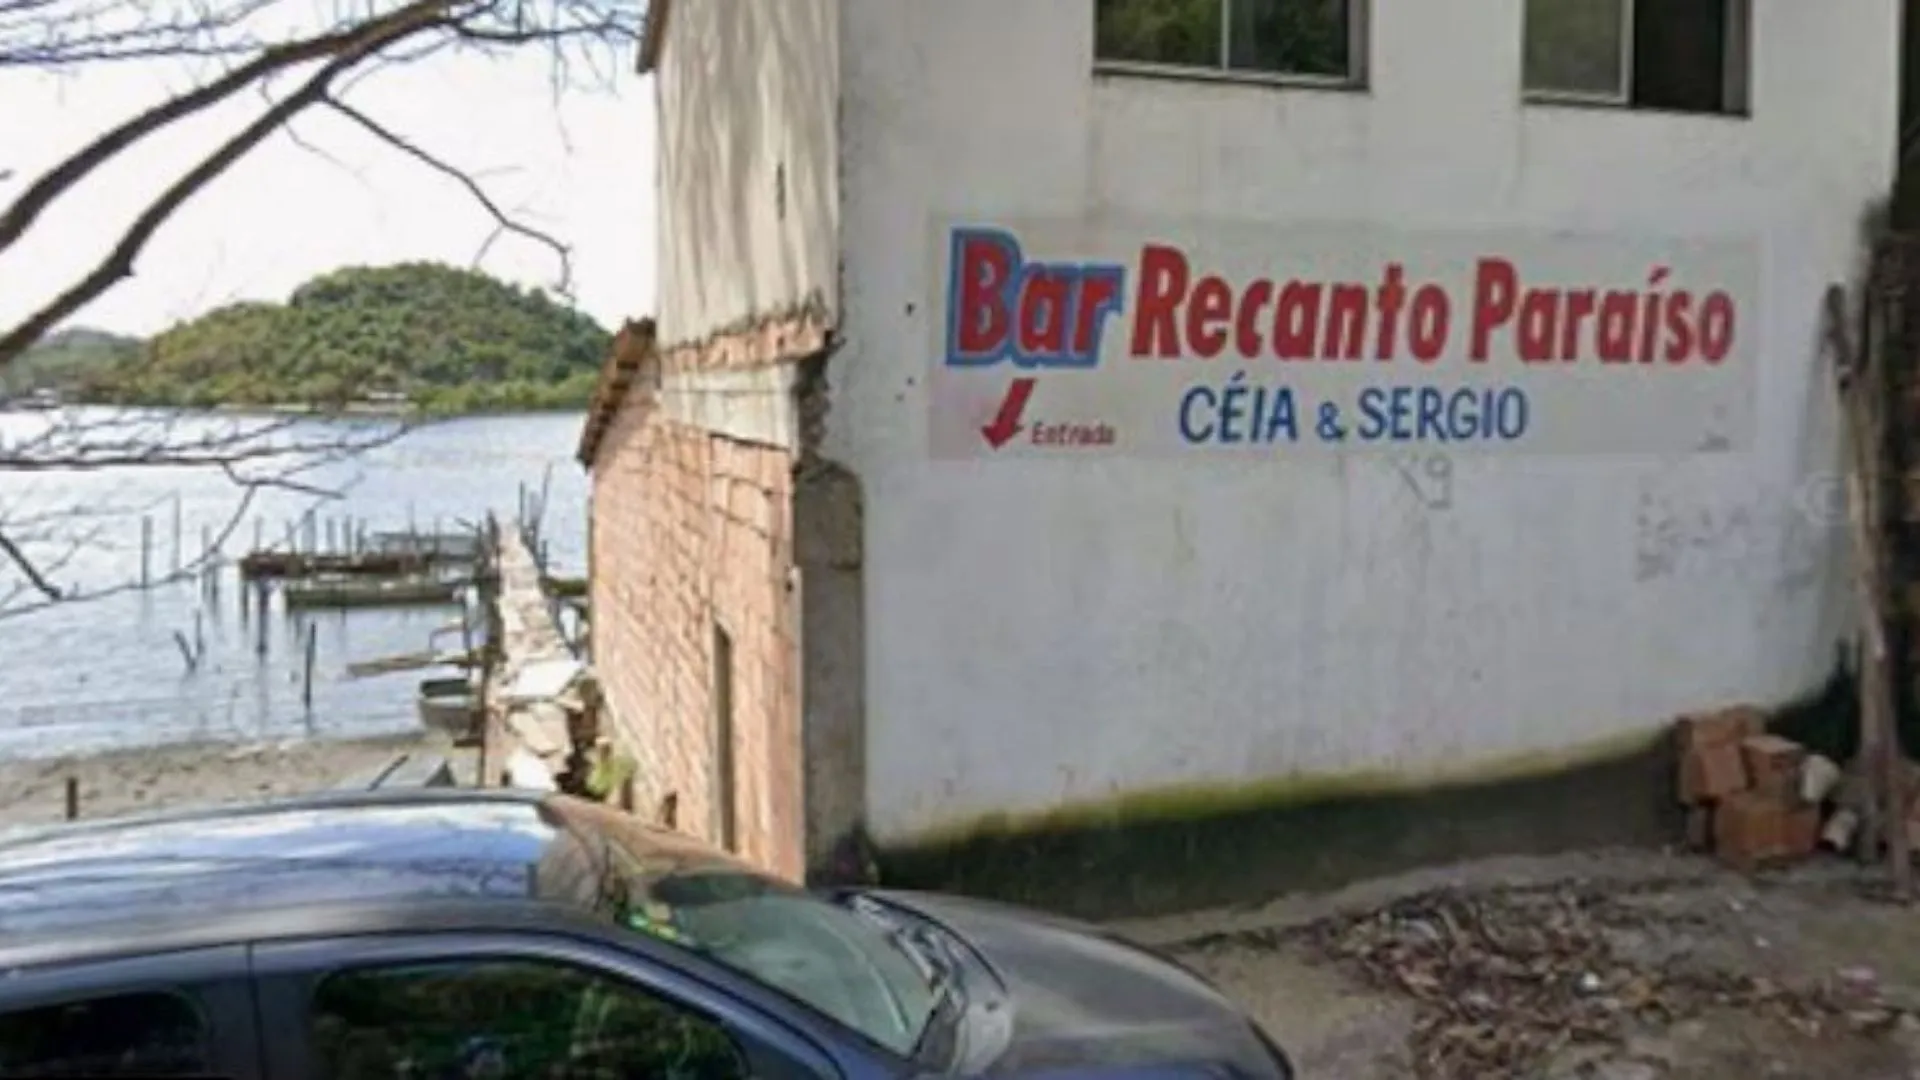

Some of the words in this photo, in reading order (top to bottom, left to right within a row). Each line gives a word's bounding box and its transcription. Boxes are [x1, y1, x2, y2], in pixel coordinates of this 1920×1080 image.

[946, 227, 1125, 368] Bar
[1130, 243, 1450, 361] Recanto
[1469, 256, 1736, 364] Paraíso
[1031, 421, 1117, 446] Entrada
[1179, 371, 1298, 444] CÉIA
[1316, 402, 1346, 440] &
[1358, 386, 1530, 442] SERGIO
